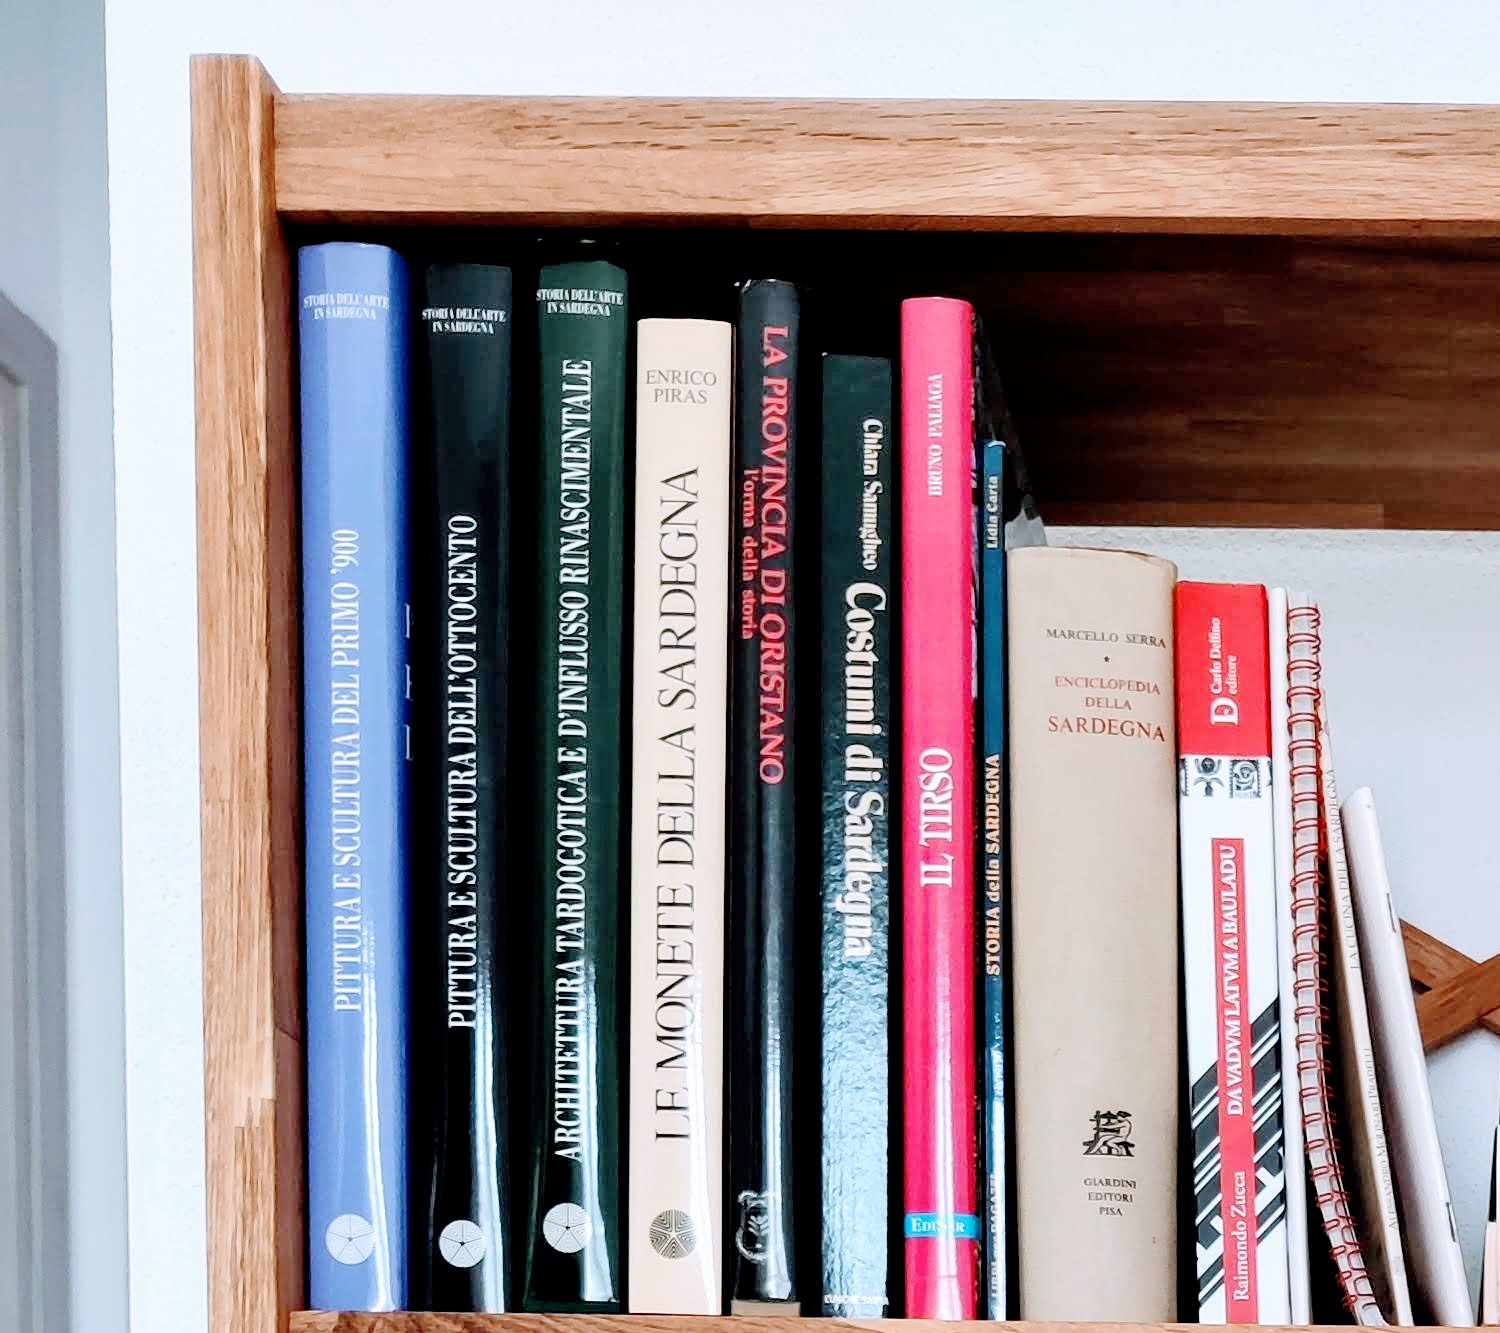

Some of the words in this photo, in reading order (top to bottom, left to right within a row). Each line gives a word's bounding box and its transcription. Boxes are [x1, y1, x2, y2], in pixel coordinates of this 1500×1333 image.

[646, 369, 717, 386] ENRICO
[761, 325, 790, 367] LA
[653, 388, 708, 405] PIRAS
[928, 373, 943, 438] PALIAGA
[560, 359, 594, 585] RINASCIMENTALE
[759, 376, 790, 558] PROVINCIA
[862, 418, 885, 476] Chiara
[928, 444, 943, 496] BRUNO
[858, 480, 885, 571] Samugheo
[657, 466, 699, 710] SARDEGNA
[759, 569, 786, 606] DI
[331, 582, 361, 668] PRIMO
[447, 514, 478, 745] DELL'OTTOCENTO
[844, 583, 887, 736] Costumi
[1046, 628, 1119, 644] MARCELLO
[1125, 633, 1167, 649] SERRA
[558, 591, 590, 738] D'INFLUSSO
[758, 612, 788, 784] ORISTANO
[1055, 675, 1161, 696] ENCICLOPEDIA
[331, 673, 360, 727] DEL
[1048, 716, 1166, 742] SARDEGNA
[1085, 697, 1132, 711] DELLA
[656, 725, 697, 870] DELLA
[844, 743, 885, 782] di
[918, 747, 955, 846] TIRSO
[332, 732, 361, 867] SCULTURA
[447, 754, 477, 885] SCULTURA
[985, 753, 1002, 856] SARDEGNA
[556, 770, 588, 953] TARDOGOTICA
[836, 791, 886, 957] Sardegna
[919, 852, 955, 888] IL
[985, 858, 1001, 903] della
[1219, 844, 1238, 935] BAULADU
[333, 895, 362, 1012] PITTURA
[448, 914, 477, 1028] PITTURA
[985, 906, 1001, 976] STORIA
[655, 884, 696, 1070] MONETE
[1222, 956, 1243, 1016] LATVM
[554, 958, 586, 1164] ARCHITETTURA
[1223, 1019, 1244, 1087] VADVM
[655, 1087, 692, 1142] LE
[1226, 1088, 1244, 1117] DA
[1083, 1177, 1137, 1190] GIARDINI
[1088, 1191, 1134, 1204] EDITORI
[1229, 1170, 1248, 1228] Zucca
[1232, 1230, 1250, 1302] Raimondo
